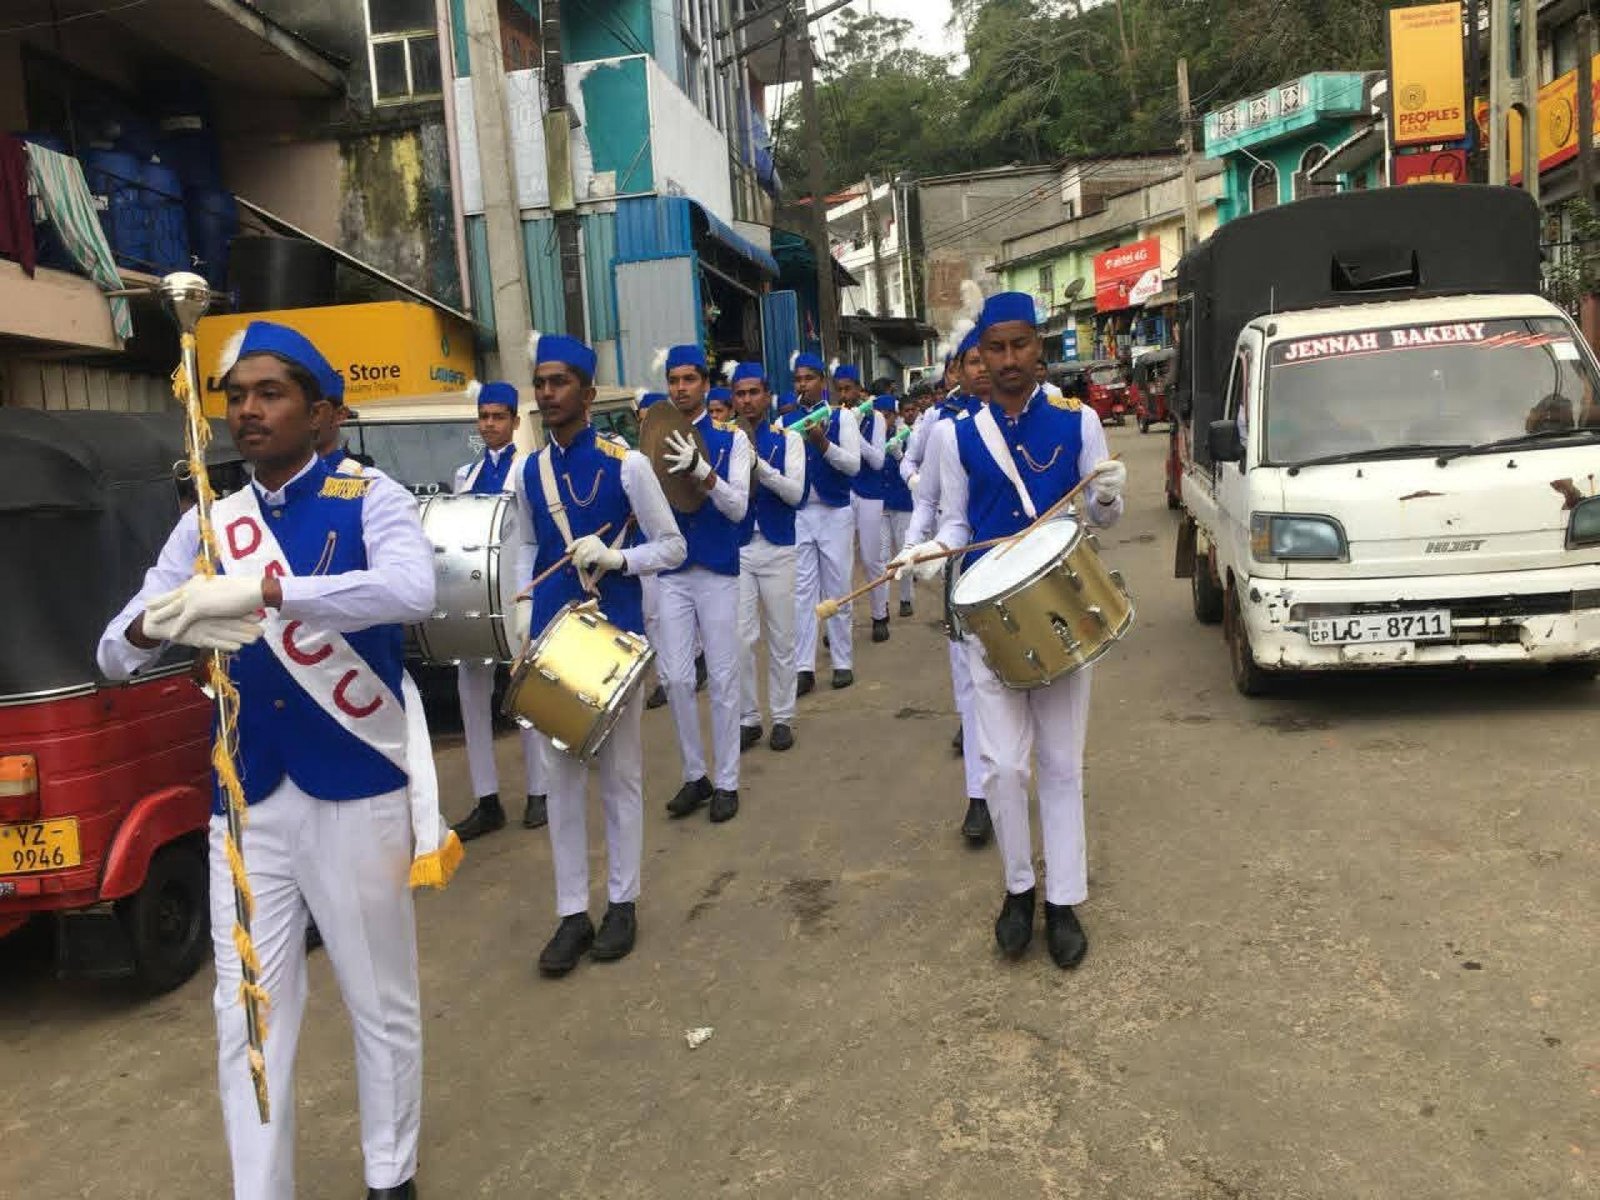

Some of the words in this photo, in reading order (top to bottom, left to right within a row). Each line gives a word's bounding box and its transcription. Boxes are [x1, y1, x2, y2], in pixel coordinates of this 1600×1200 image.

[1285, 332, 1379, 361] JENNAH
[1391, 323, 1486, 347] BAKERY
[349, 363, 401, 381] Store
[1425, 539, 1488, 553] HIJET
[12, 846, 65, 871] 9946
